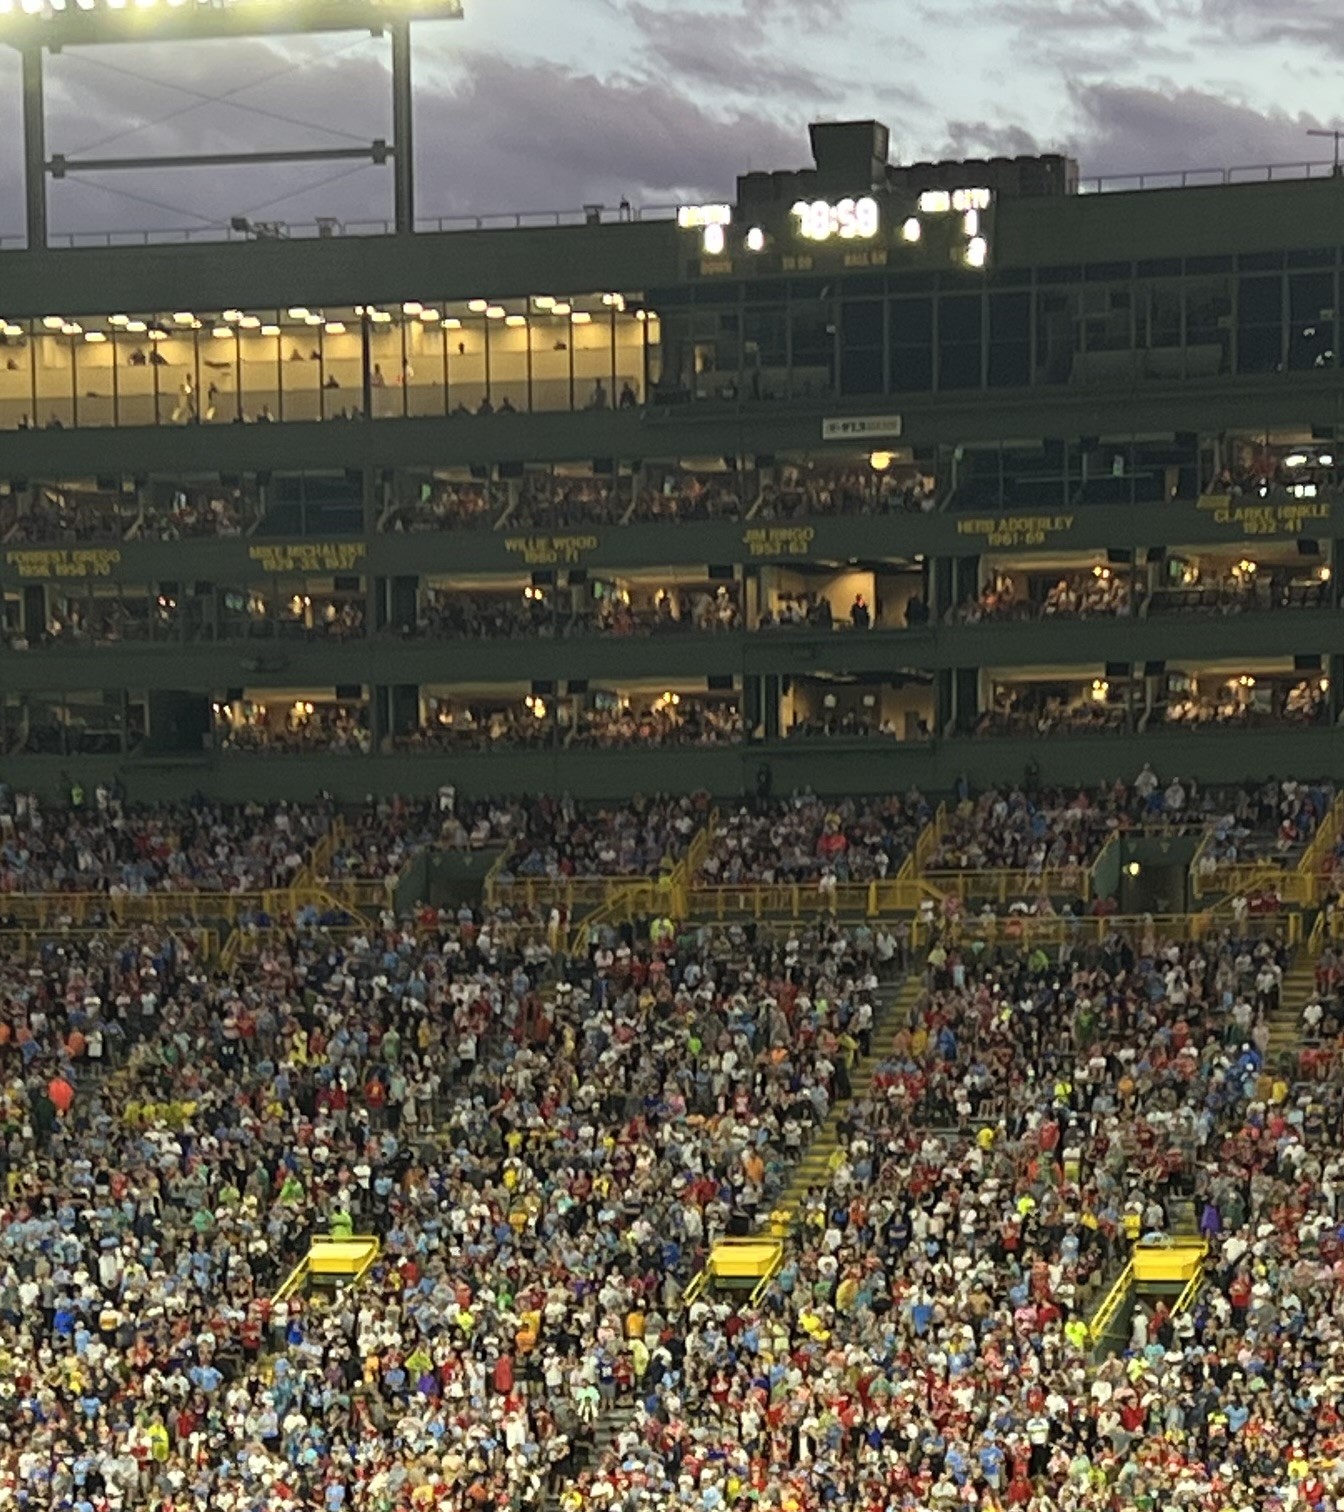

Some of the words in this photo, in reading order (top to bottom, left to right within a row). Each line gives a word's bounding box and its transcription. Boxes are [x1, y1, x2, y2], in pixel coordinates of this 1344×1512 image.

[1214, 506, 1274, 523] CLARKE
[1277, 503, 1330, 519] HINKLE
[957, 519, 996, 534] HERB
[998, 516, 1074, 532] ADDERLEY
[504, 537, 548, 552] WILLIE
[552, 535, 598, 550] WOOD
[742, 529, 766, 543] JIM
[769, 528, 814, 542] RINGO
[72, 549, 120, 564] GREGG
